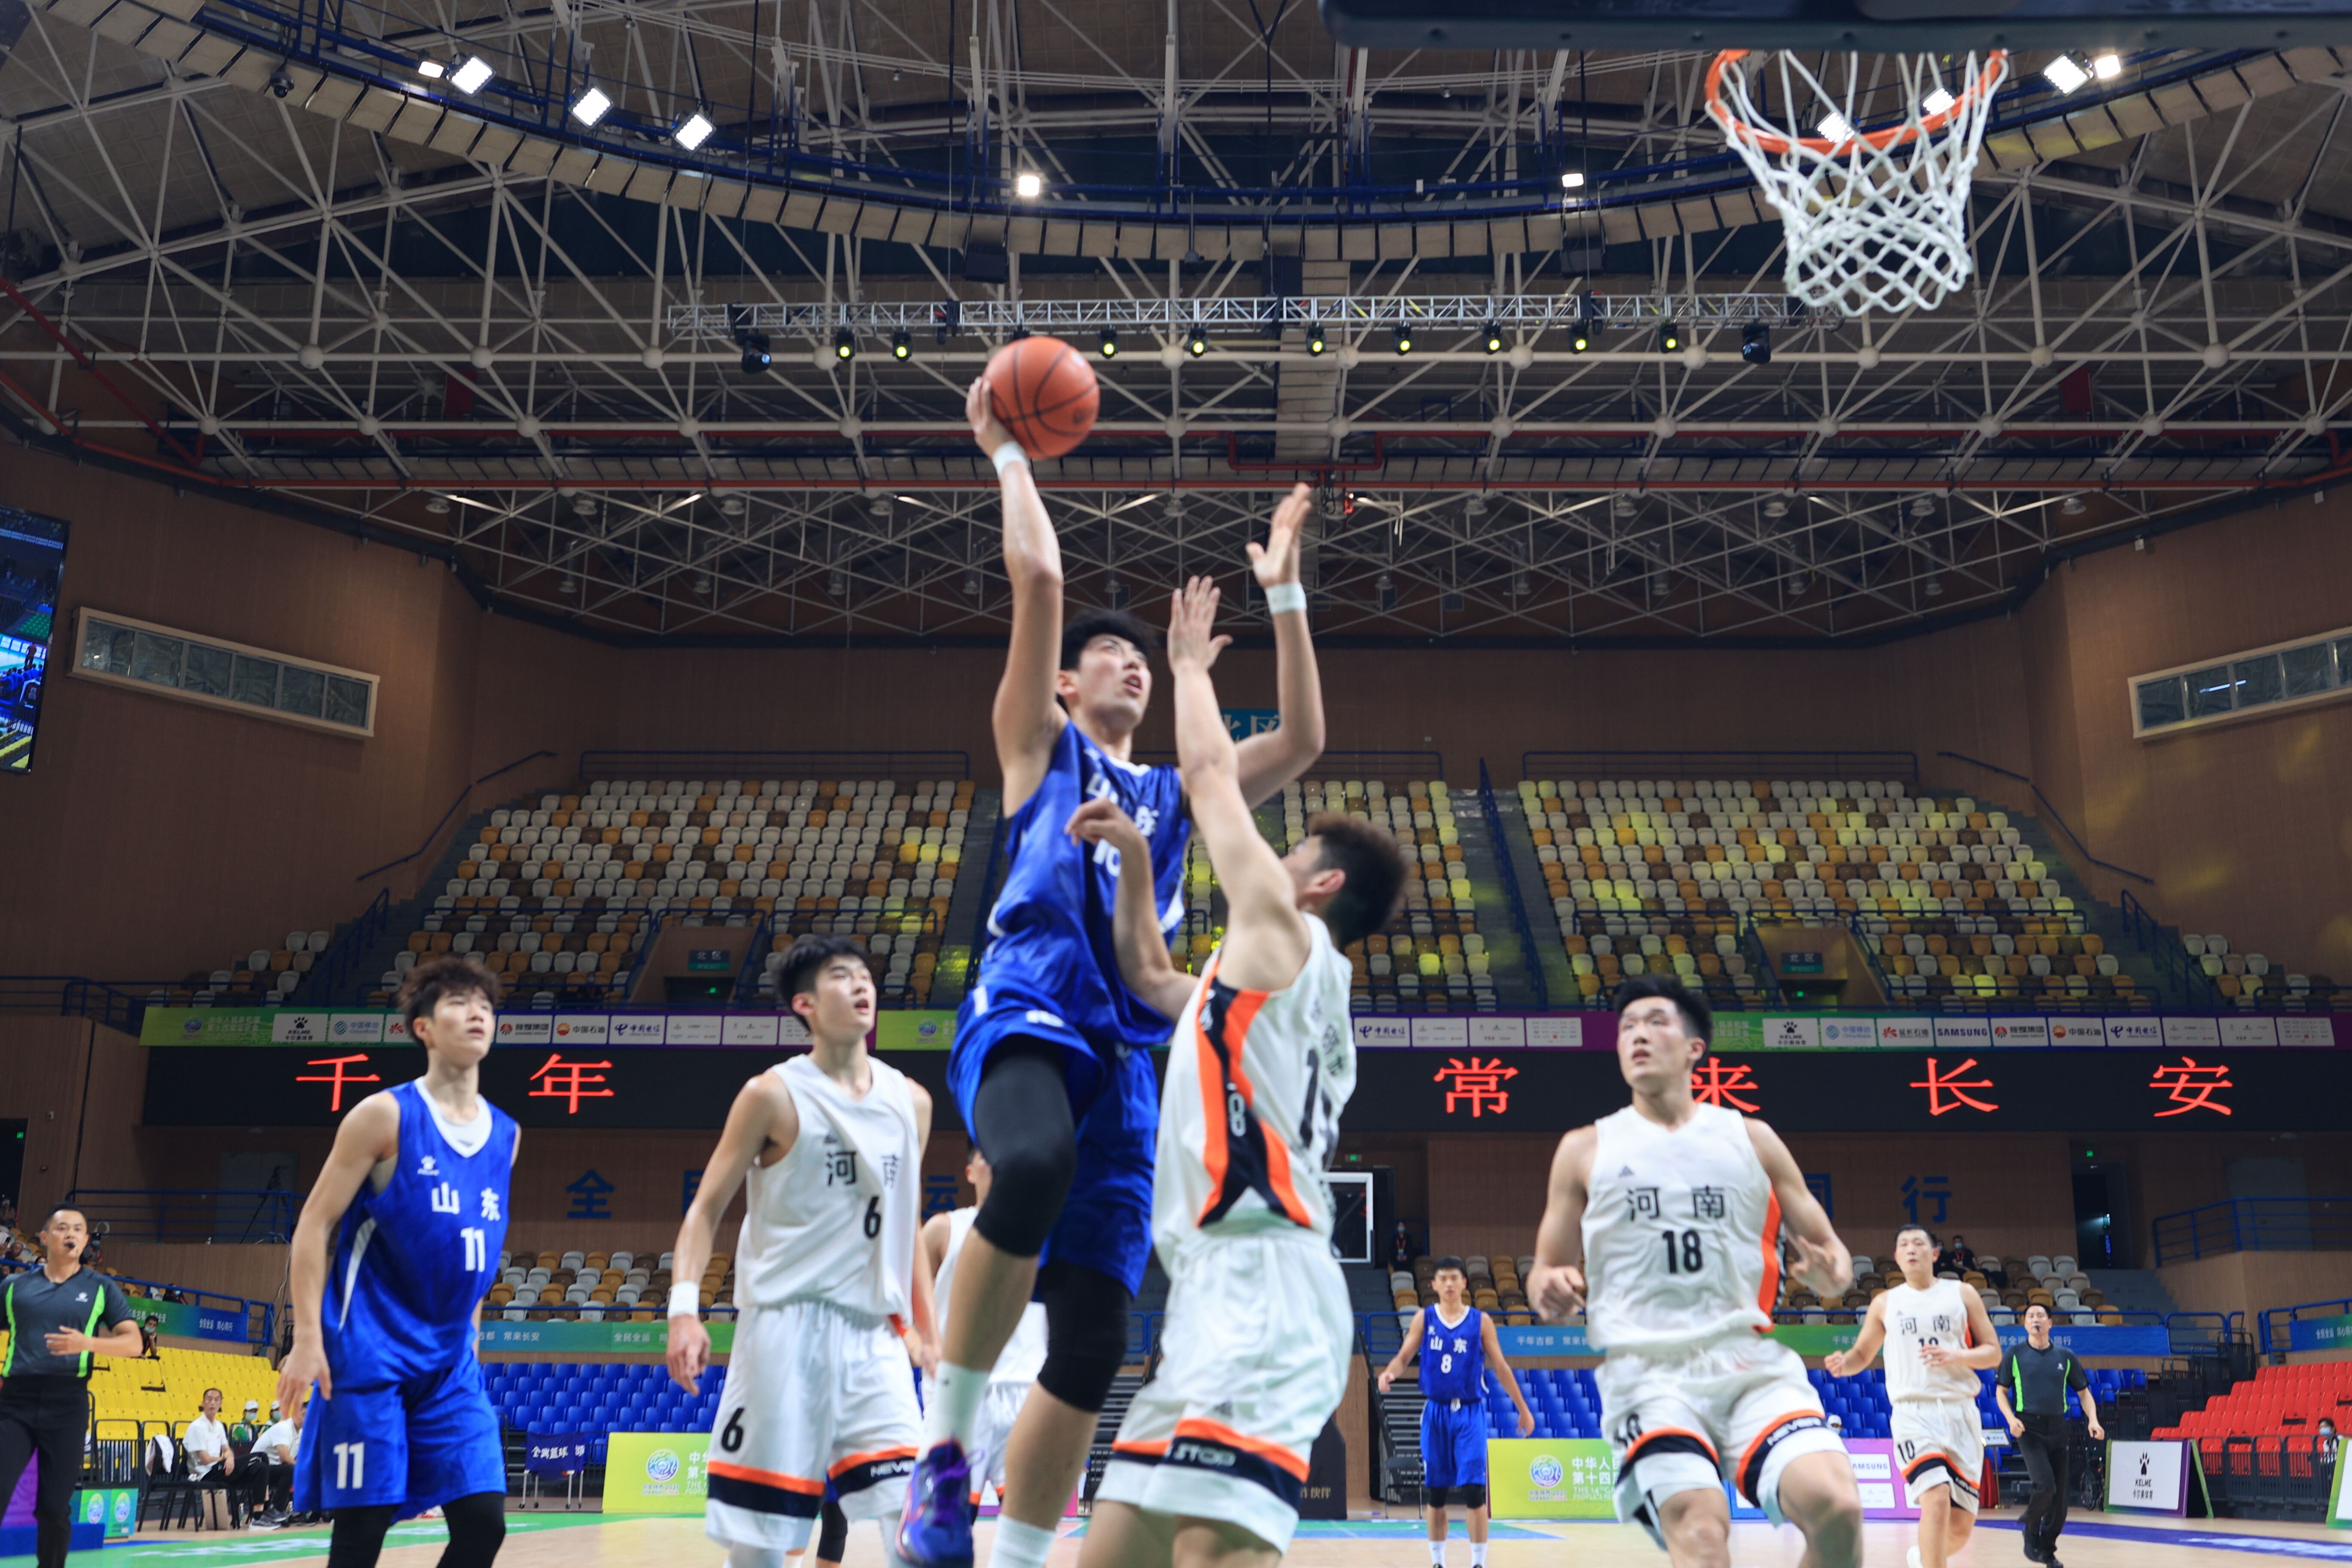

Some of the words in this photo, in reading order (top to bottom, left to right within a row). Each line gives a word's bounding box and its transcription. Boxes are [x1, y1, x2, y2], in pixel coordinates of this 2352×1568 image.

[697, 951, 722, 961] 北区
[1790, 953, 1815, 963] 北区
[573, 1026, 605, 1034] 中国石油
[1899, 1028, 1929, 1036] 延长石油
[1937, 1028, 1988, 1036] SAMSUNG
[296, 1054, 380, 1112] 千
[529, 1054, 613, 1114] 年
[1433, 1057, 1519, 1117] 常
[1689, 1057, 1760, 1112] 来
[1909, 1057, 1999, 1116] 长
[2150, 1056, 2233, 1117] 安
[431, 1181, 501, 1221] 山东
[566, 1169, 616, 1219] 全
[1900, 1175, 1952, 1224] 行
[1627, 1185, 1725, 1220] 河南
[864, 1195, 881, 1240] 6
[460, 1226, 486, 1273] 11
[1663, 1228, 1703, 1274] 18
[1900, 1314, 1950, 1335] 河南
[1430, 1336, 1467, 1354] 山东
[1440, 1353, 1452, 1374] 8
[721, 1407, 747, 1454] 6
[1767, 1418, 1822, 1446] NEVER
[1172, 1442, 1237, 1467] STOP
[1897, 1440, 1915, 1464] 10
[333, 1441, 365, 1490] 11
[2132, 1489, 2153, 1500] 卡尔美体育
[2135, 1478, 2152, 1487] KELME
